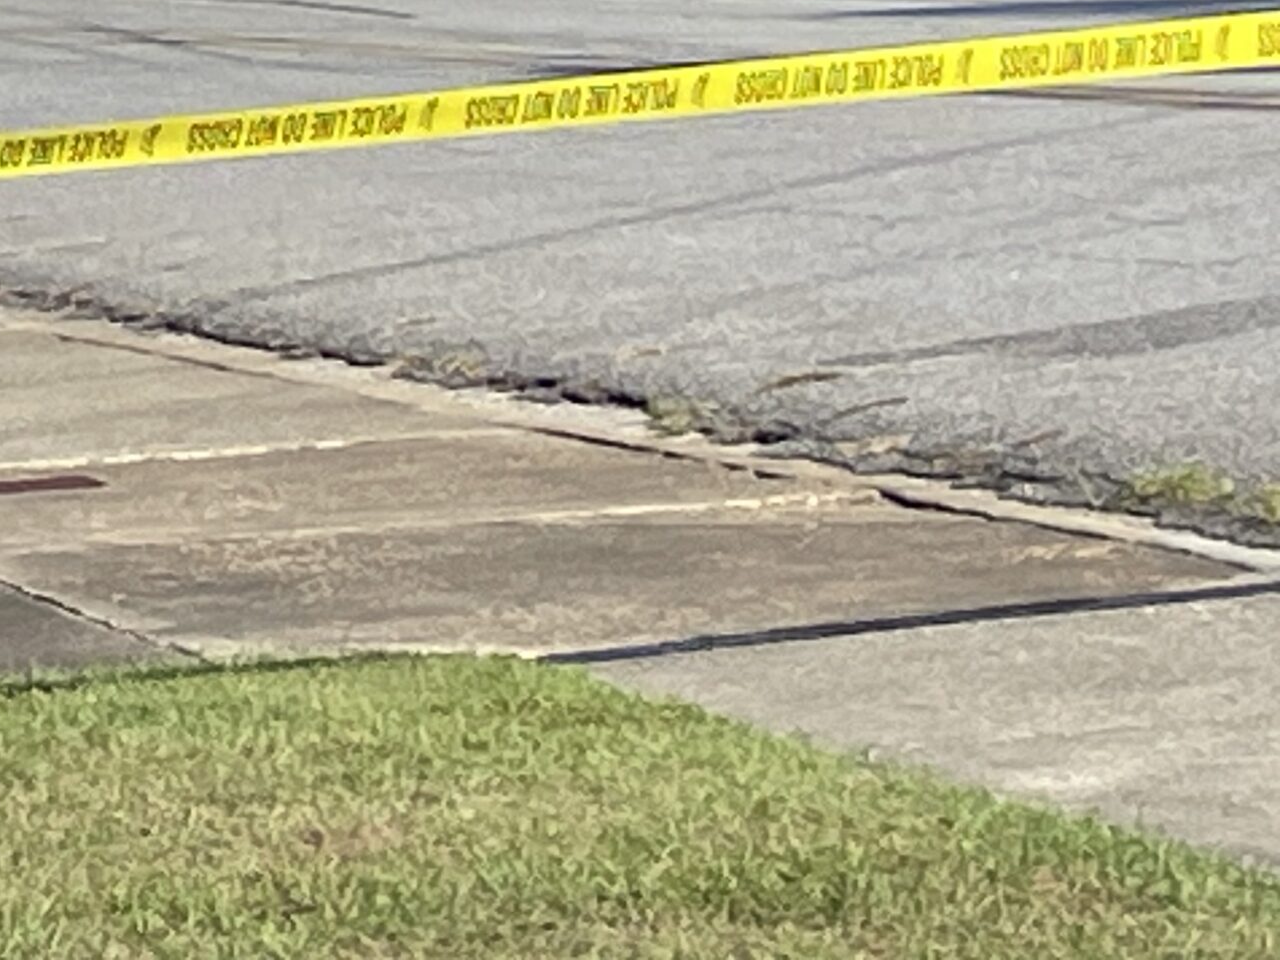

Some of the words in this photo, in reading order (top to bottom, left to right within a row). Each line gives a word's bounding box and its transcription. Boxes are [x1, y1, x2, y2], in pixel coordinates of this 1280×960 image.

[1051, 40, 1084, 74] NOT
[1087, 38, 1108, 71] DO
[1112, 35, 1145, 69] LINE
[1148, 30, 1202, 66] POLICE
[789, 64, 823, 98] NOT
[825, 61, 848, 95] DO
[852, 58, 885, 92] LINE
[888, 53, 944, 89] POLICE
[520, 89, 554, 123] NOT
[556, 87, 581, 119] DO
[583, 83, 620, 117] LINE
[621, 77, 679, 113] POLICE
[244, 115, 279, 147] NOT
[282, 113, 307, 143] DO
[310, 109, 347, 140] LINE
[350, 103, 407, 136] POLICE
[0, 138, 25, 168] DO
[27, 134, 65, 165] LINE
[68, 128, 128, 162] POLICE
